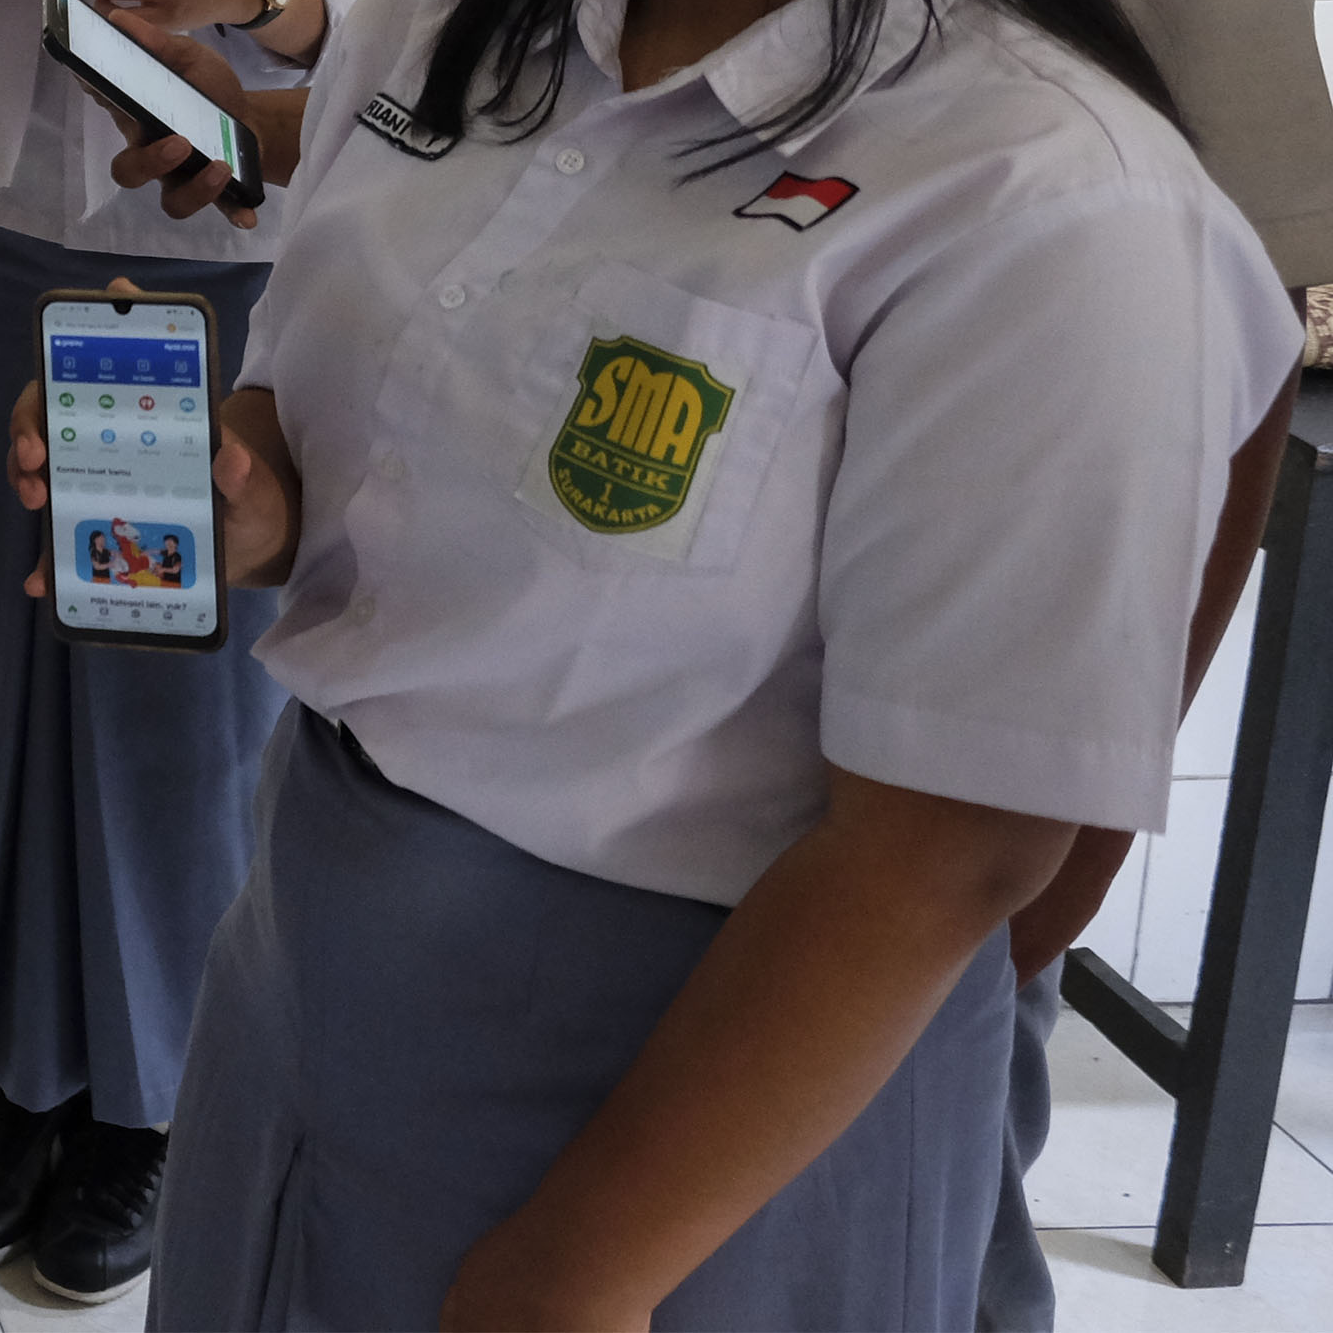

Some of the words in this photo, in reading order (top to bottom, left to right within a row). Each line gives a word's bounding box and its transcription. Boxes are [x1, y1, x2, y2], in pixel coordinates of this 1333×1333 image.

[575, 355, 703, 466] SMA
[571, 439, 671, 490] BATIK
[556, 468, 662, 524] SURAKARTA
[599, 481, 614, 504] 1
